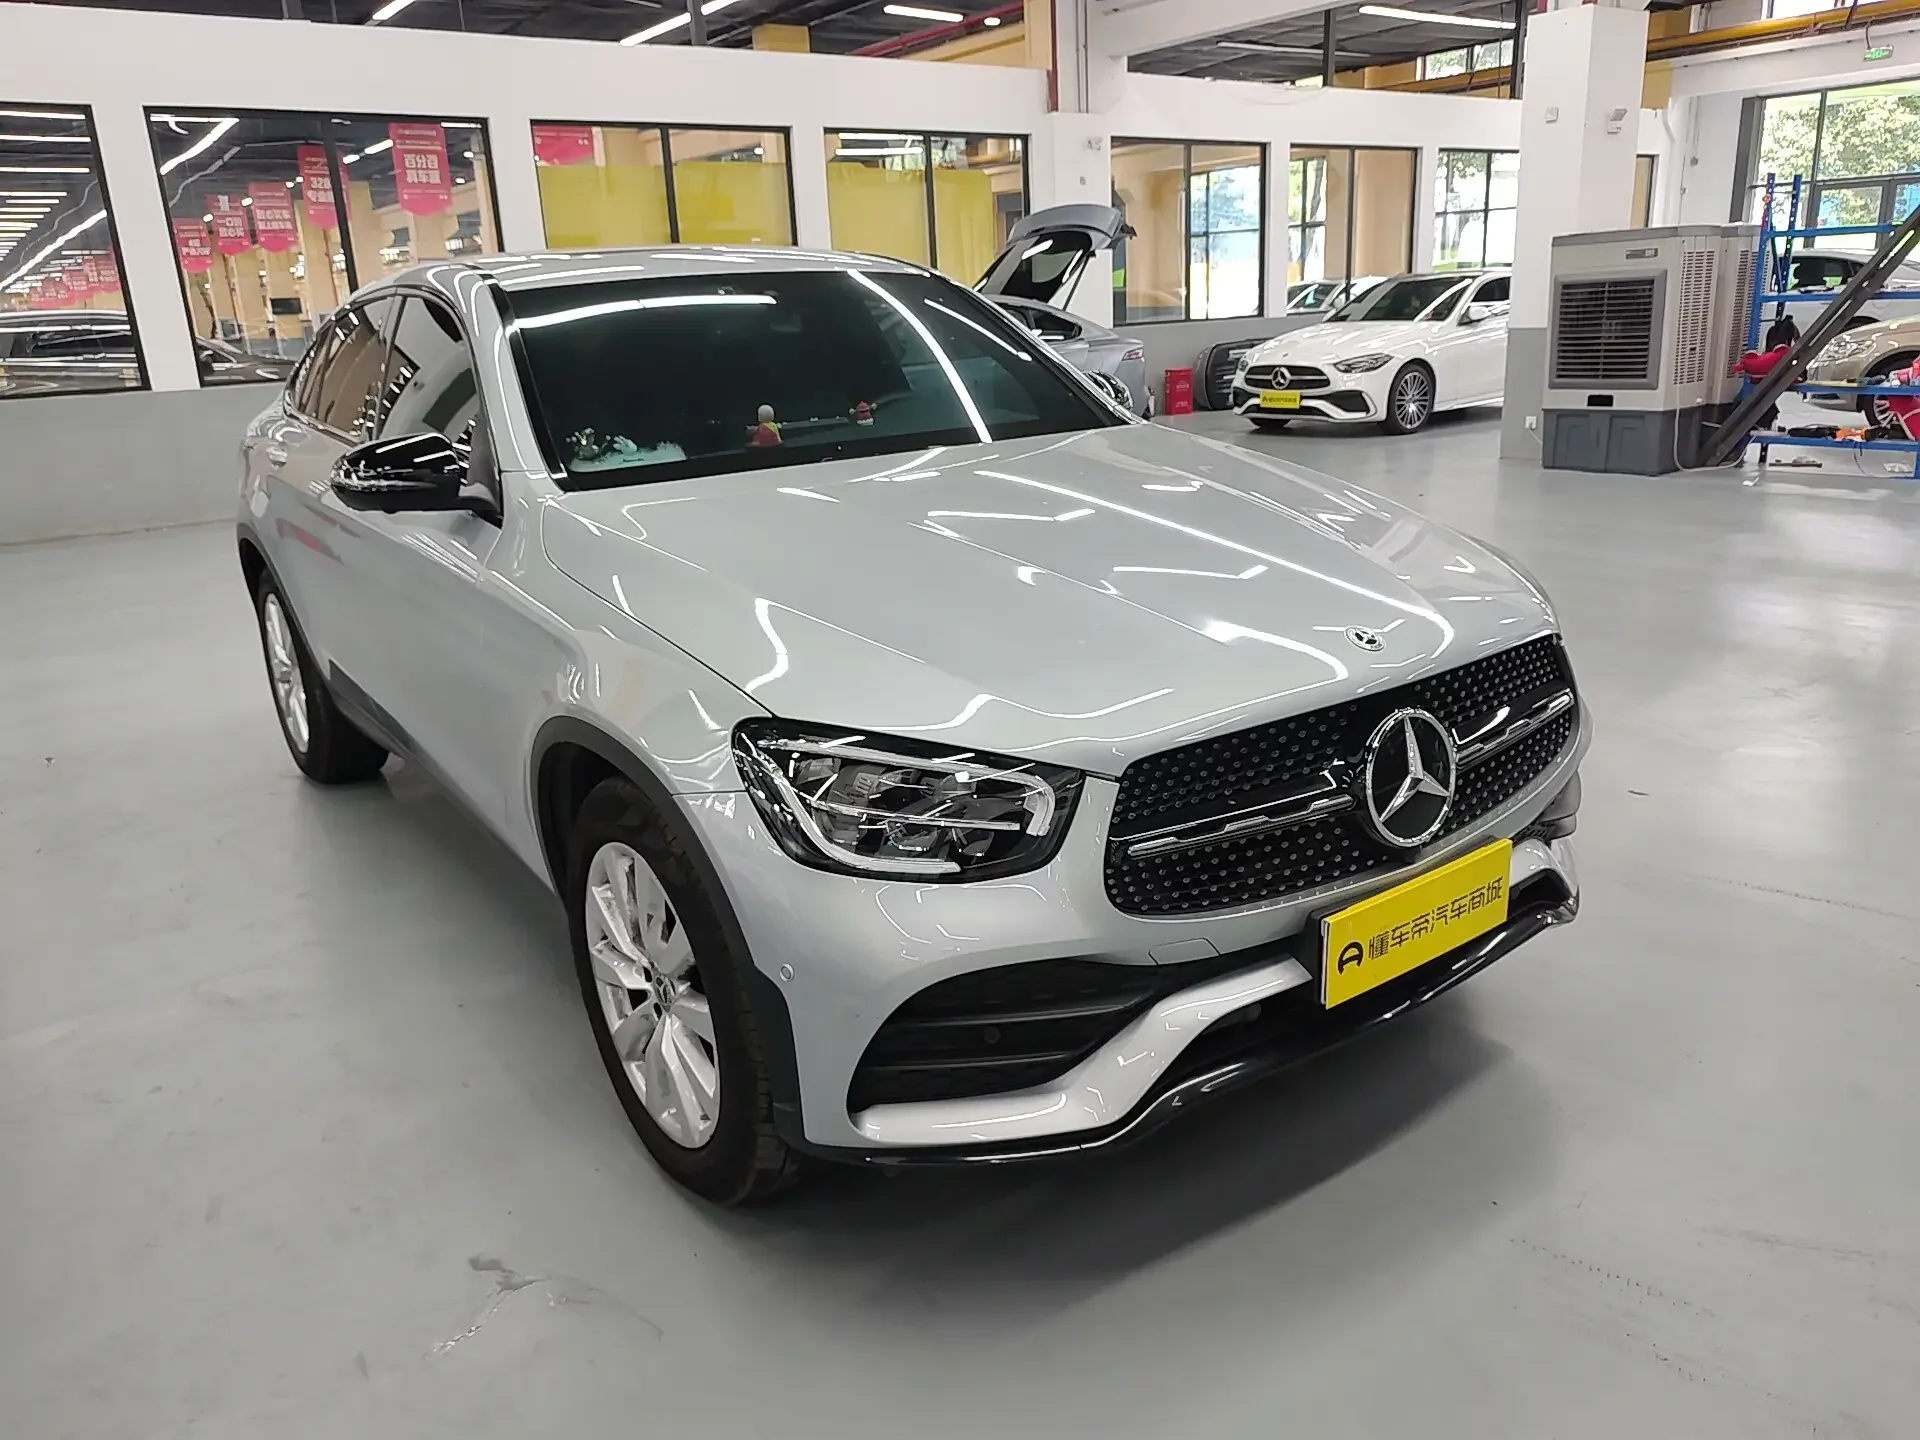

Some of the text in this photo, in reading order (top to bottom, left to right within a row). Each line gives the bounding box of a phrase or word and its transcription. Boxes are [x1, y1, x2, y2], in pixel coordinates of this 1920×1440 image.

[404, 153, 439, 169] 百分百
[1367, 875, 1504, 961] 懂车帝汽车商城
